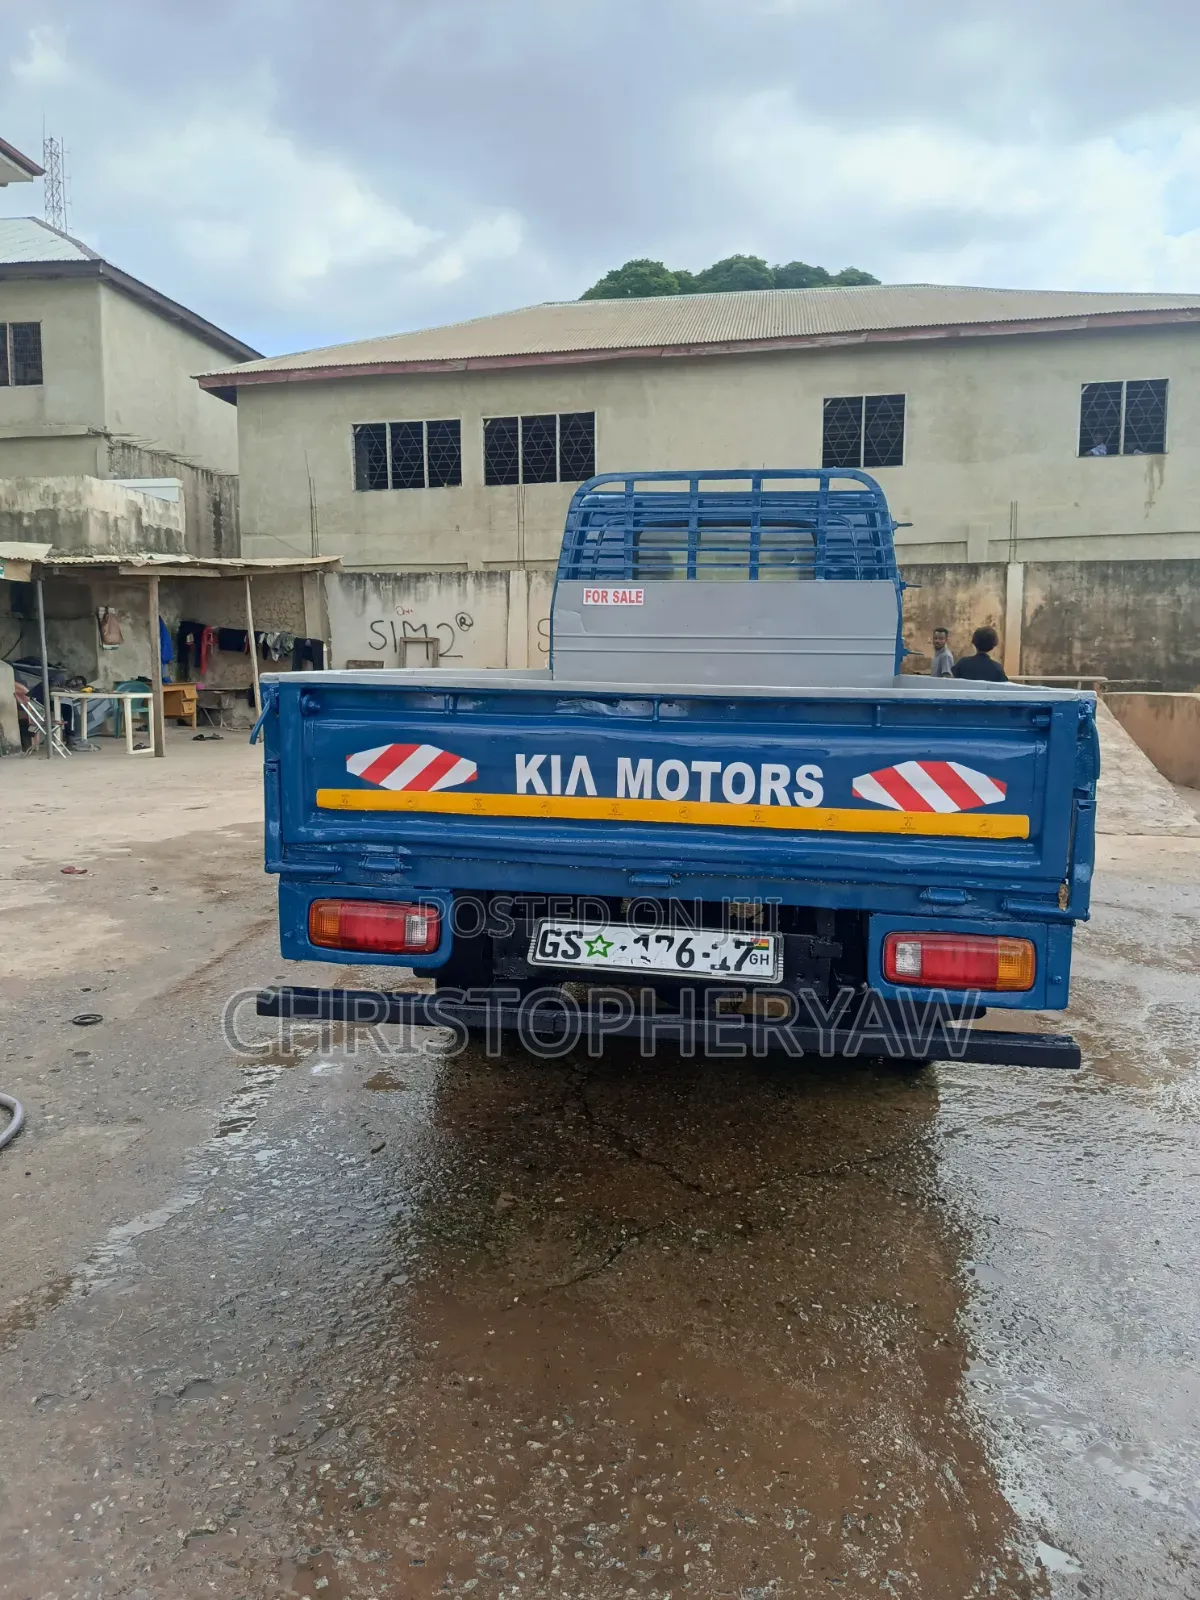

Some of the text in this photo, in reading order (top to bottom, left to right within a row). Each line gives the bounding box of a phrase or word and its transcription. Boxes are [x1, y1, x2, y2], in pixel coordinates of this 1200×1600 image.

[585, 590, 643, 604] FOR SALE
[515, 753, 824, 808] KIA MOTORS
[539, 929, 584, 960] GS
[749, 953, 770, 966] GH
